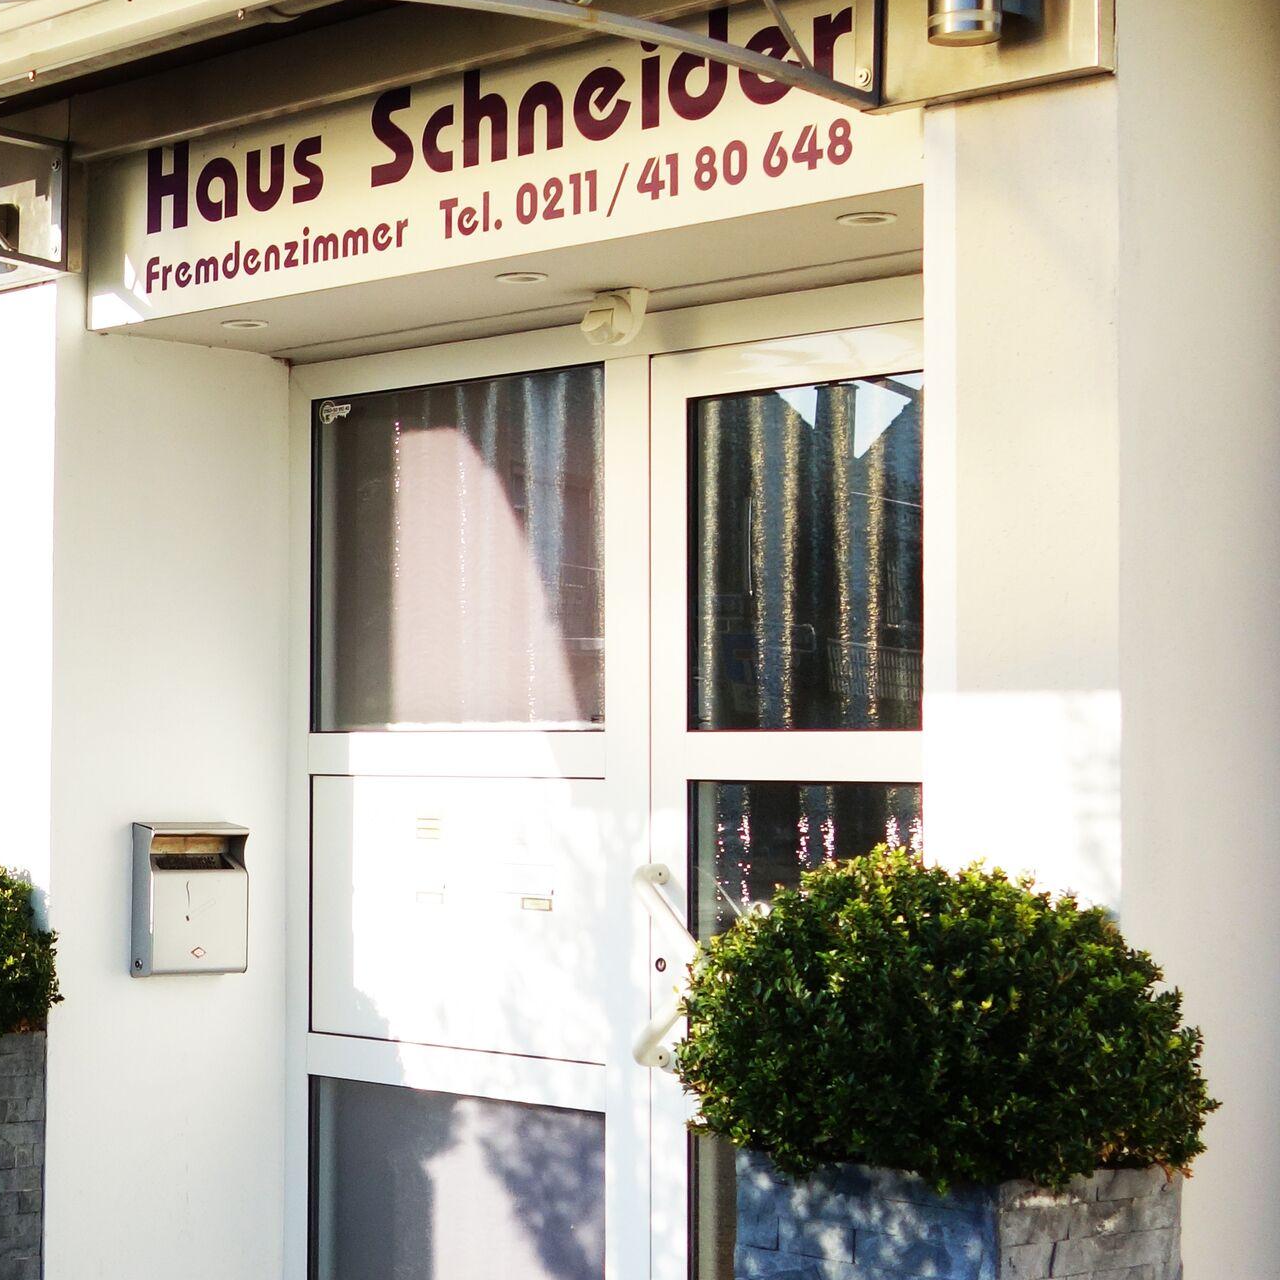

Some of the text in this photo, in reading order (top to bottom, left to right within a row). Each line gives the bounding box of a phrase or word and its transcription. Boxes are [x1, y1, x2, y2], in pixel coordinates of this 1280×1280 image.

[145, 218, 409, 294] Fremdenzimmer
[439, 190, 503, 239] Tel.
[694, 139, 748, 191] 80
[762, 118, 853, 179] 648
[146, 6, 853, 235] Haus Schneider
